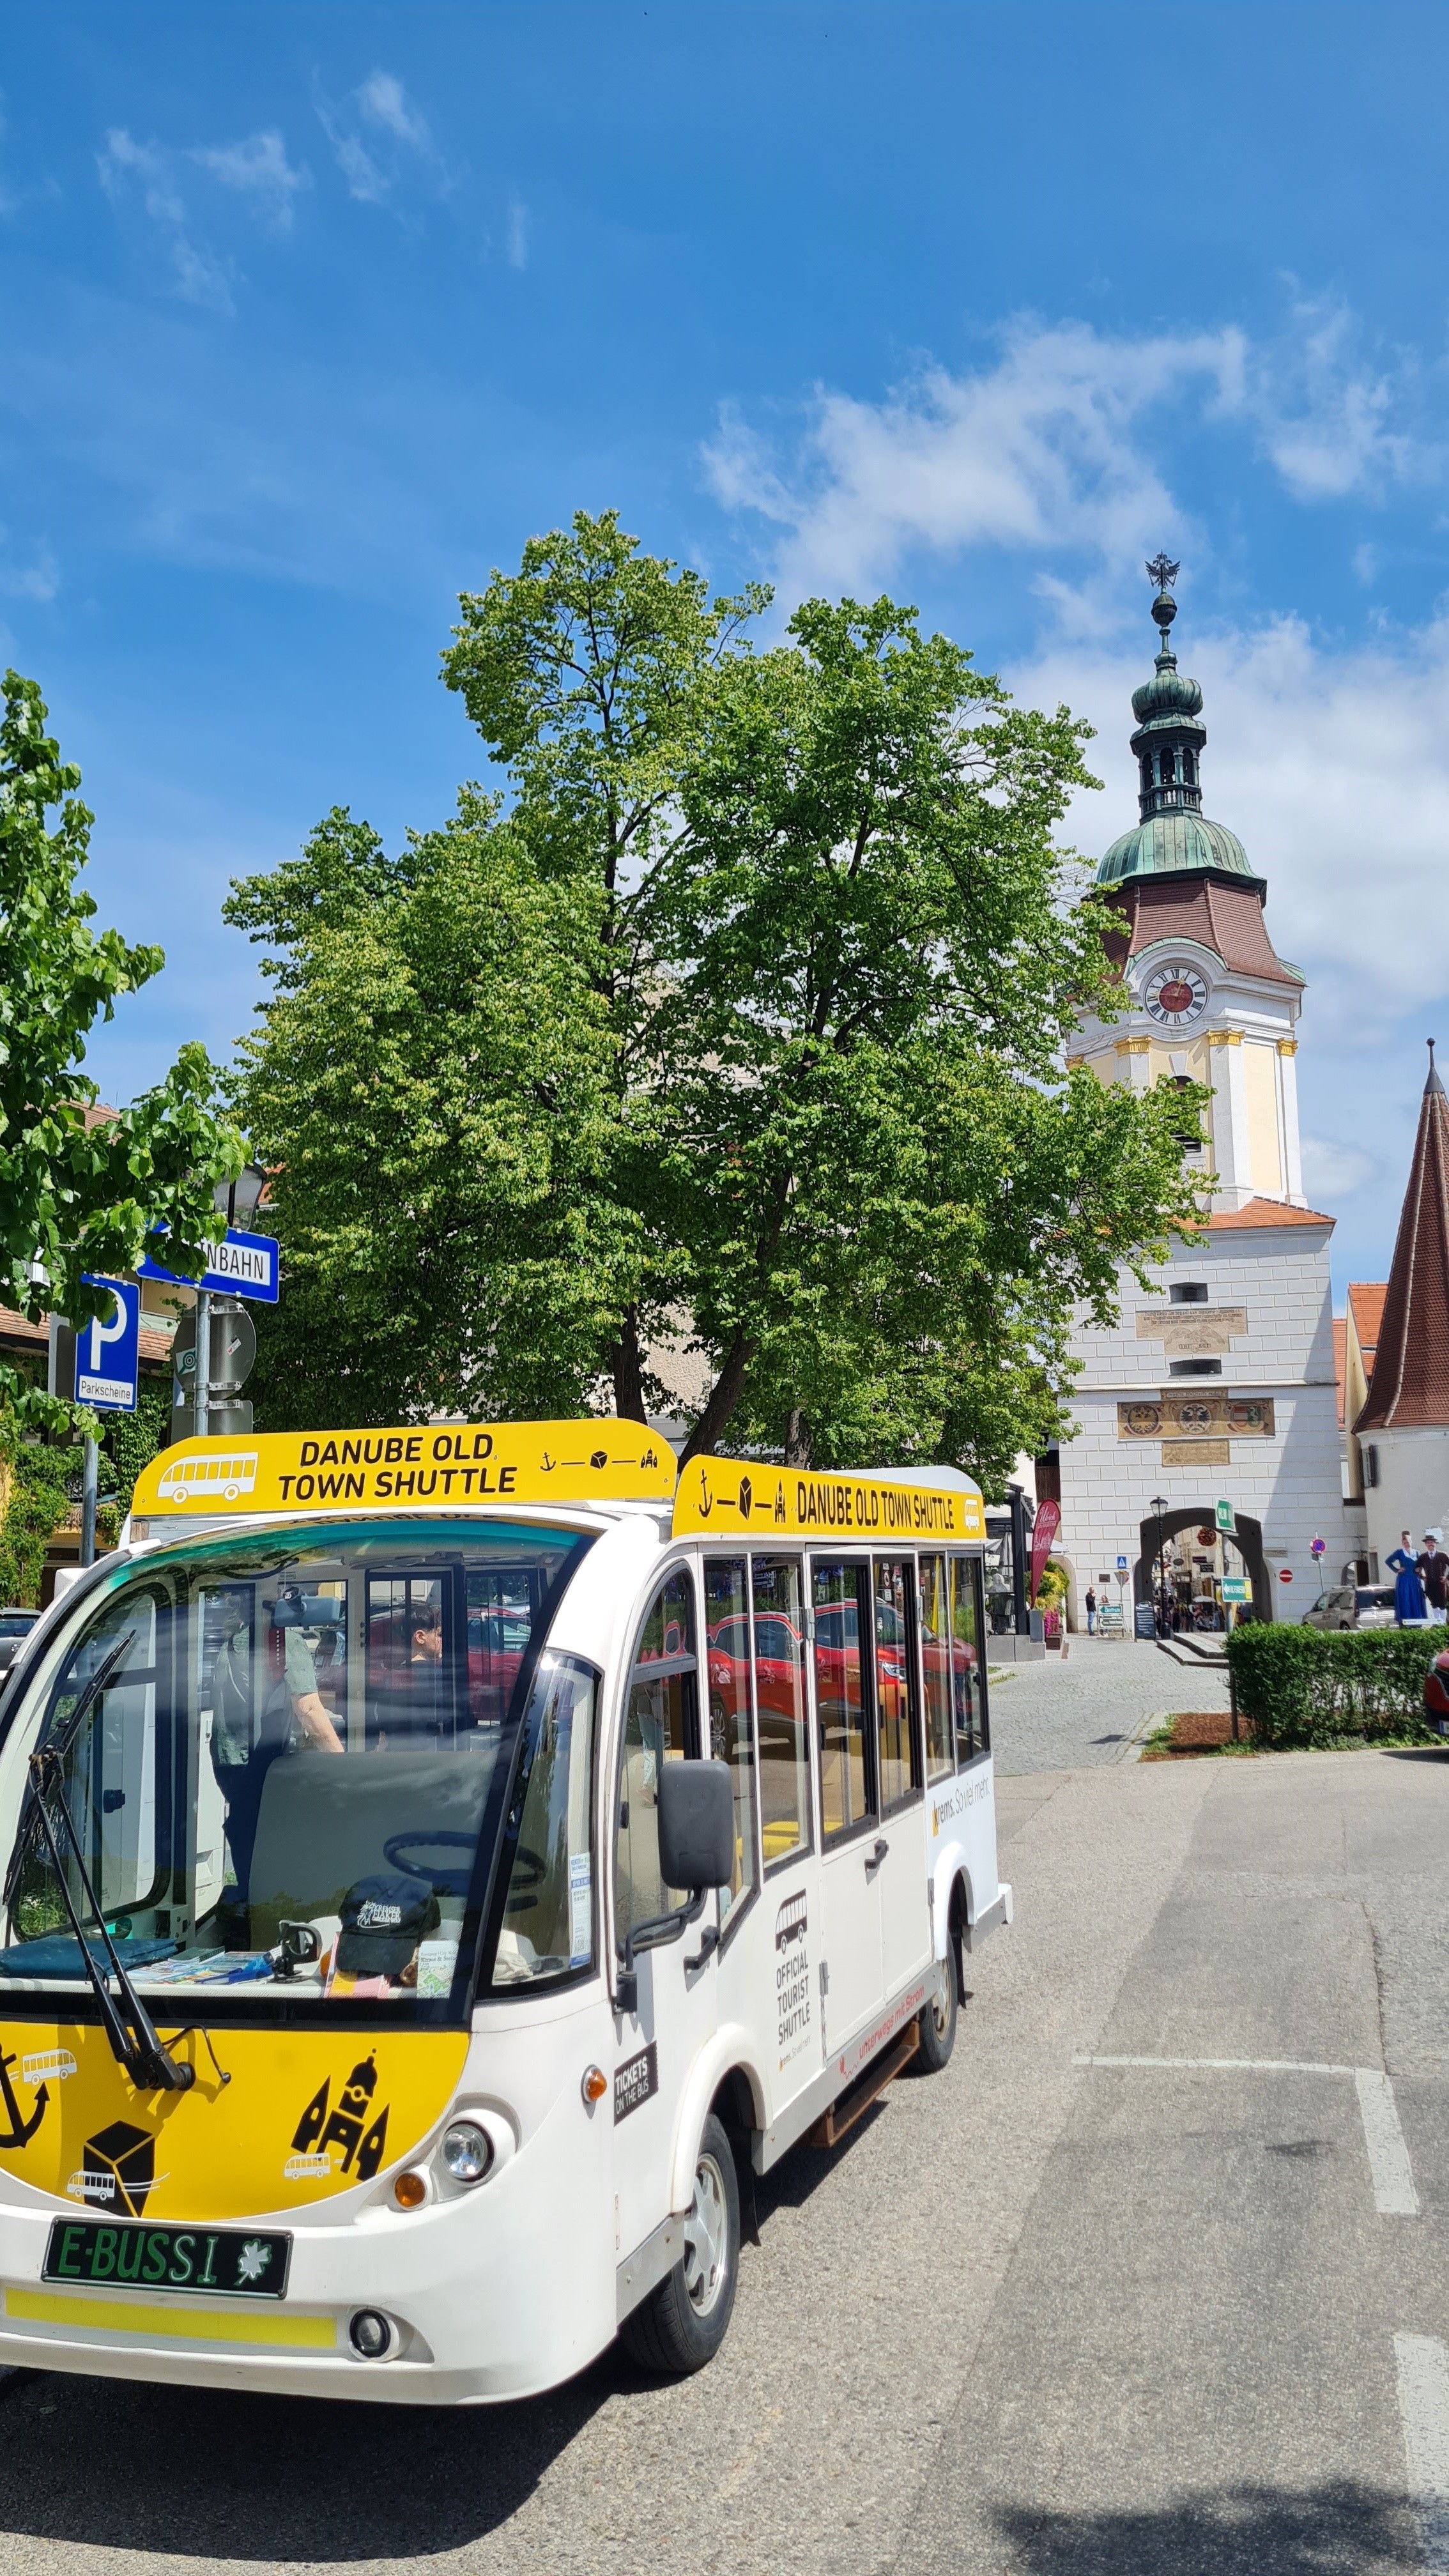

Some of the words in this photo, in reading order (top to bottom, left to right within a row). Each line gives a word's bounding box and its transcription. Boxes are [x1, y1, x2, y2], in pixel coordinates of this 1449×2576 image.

[200, 1242, 263, 1280] NBAHN
[91, 1285, 128, 1371] P
[81, 1380, 131, 1399] Parkscheine
[300, 1436, 424, 1467] DANUBE
[433, 1434, 493, 1461] OLD
[278, 1472, 365, 1501] TOWN
[374, 1466, 518, 1497] SHUTTLE
[797, 1481, 853, 1526] DANUBE
[855, 1487, 878, 1526] OLD
[881, 1491, 912, 1528] TOWN
[914, 1494, 954, 1529] SHUTTLE
[933, 1799, 955, 1828] krems.
[776, 1949, 809, 1989] OFFICIAL
[777, 1974, 809, 2017] TOURIST
[778, 2001, 810, 2046] SHUTTLE
[859, 2014, 894, 2060] unterwegs
[615, 2055, 648, 2096] TICKETS
[615, 2098, 625, 2115] ON
[625, 2087, 637, 2107] THE
[638, 2078, 649, 2097] BUS
[58, 2227, 219, 2284] E-BUSSI
